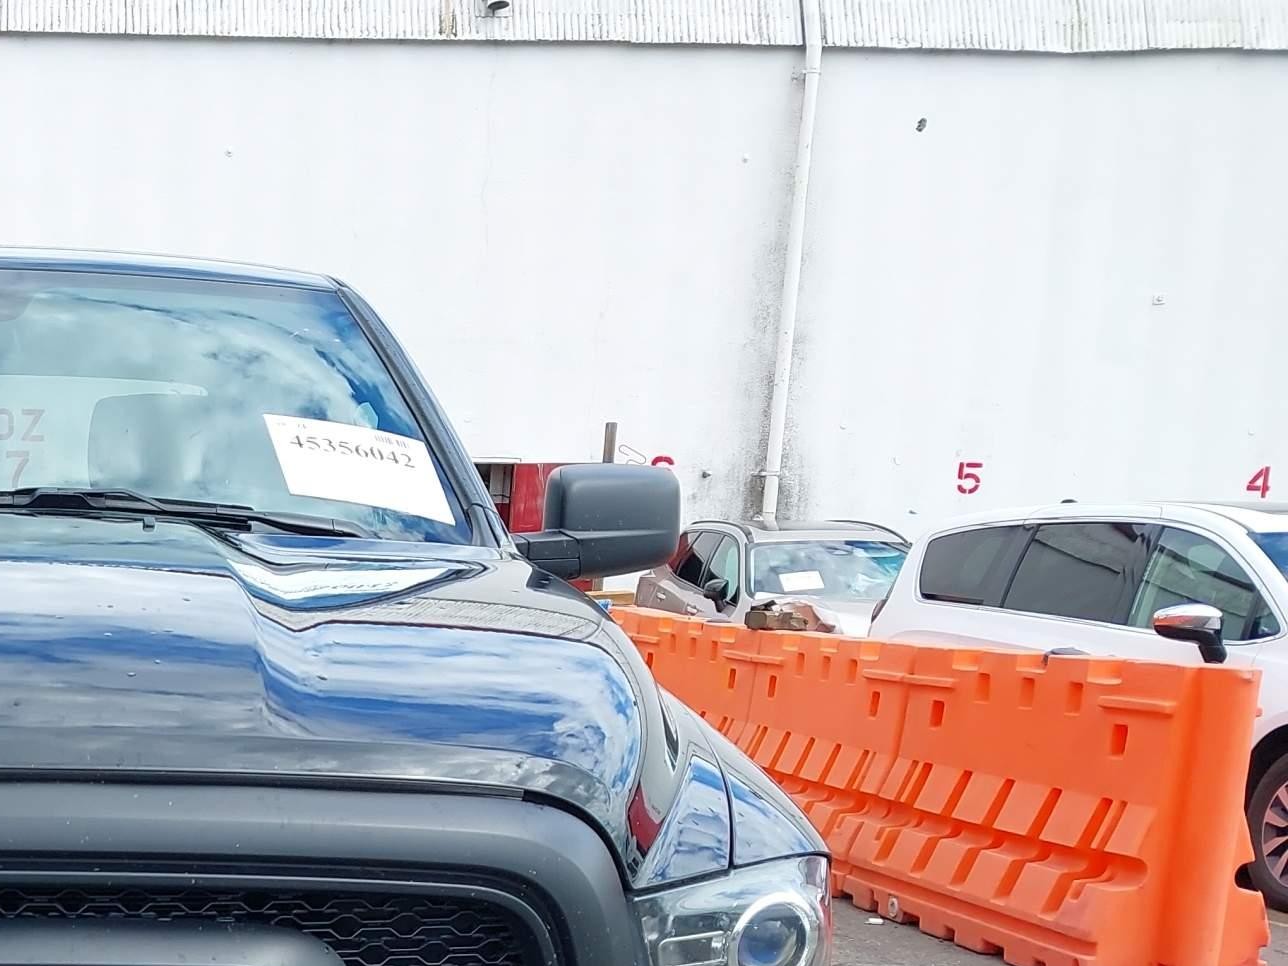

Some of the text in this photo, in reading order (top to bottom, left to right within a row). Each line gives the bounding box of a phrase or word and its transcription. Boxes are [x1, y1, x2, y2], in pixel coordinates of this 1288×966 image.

[6, 450, 30, 488] 7
[290, 435, 416, 469] 45356042
[956, 461, 984, 495] 5
[1245, 466, 1271, 498] 4
